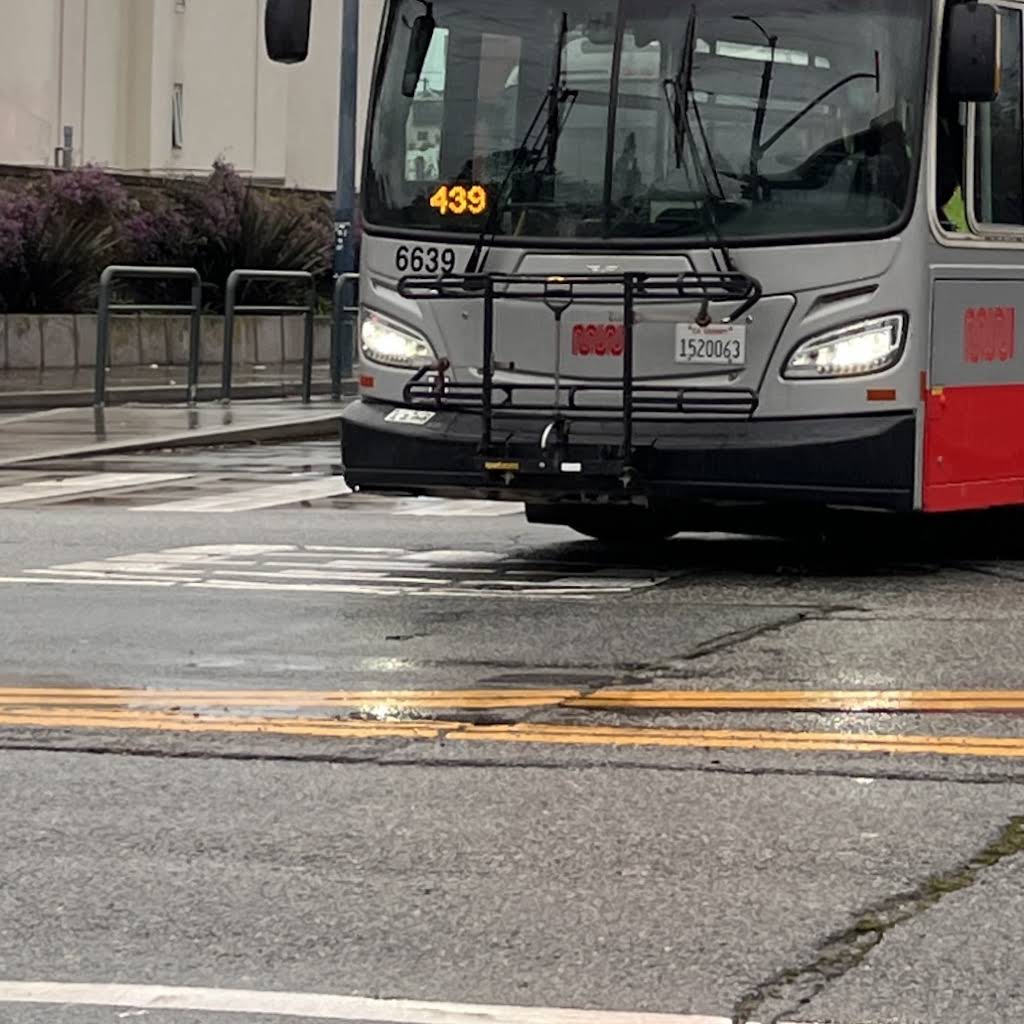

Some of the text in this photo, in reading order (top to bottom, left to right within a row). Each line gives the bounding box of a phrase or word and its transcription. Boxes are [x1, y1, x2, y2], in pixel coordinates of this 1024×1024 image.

[429, 185, 486, 214] 439
[396, 245, 455, 273] 6639
[680, 338, 741, 359] 1520063
